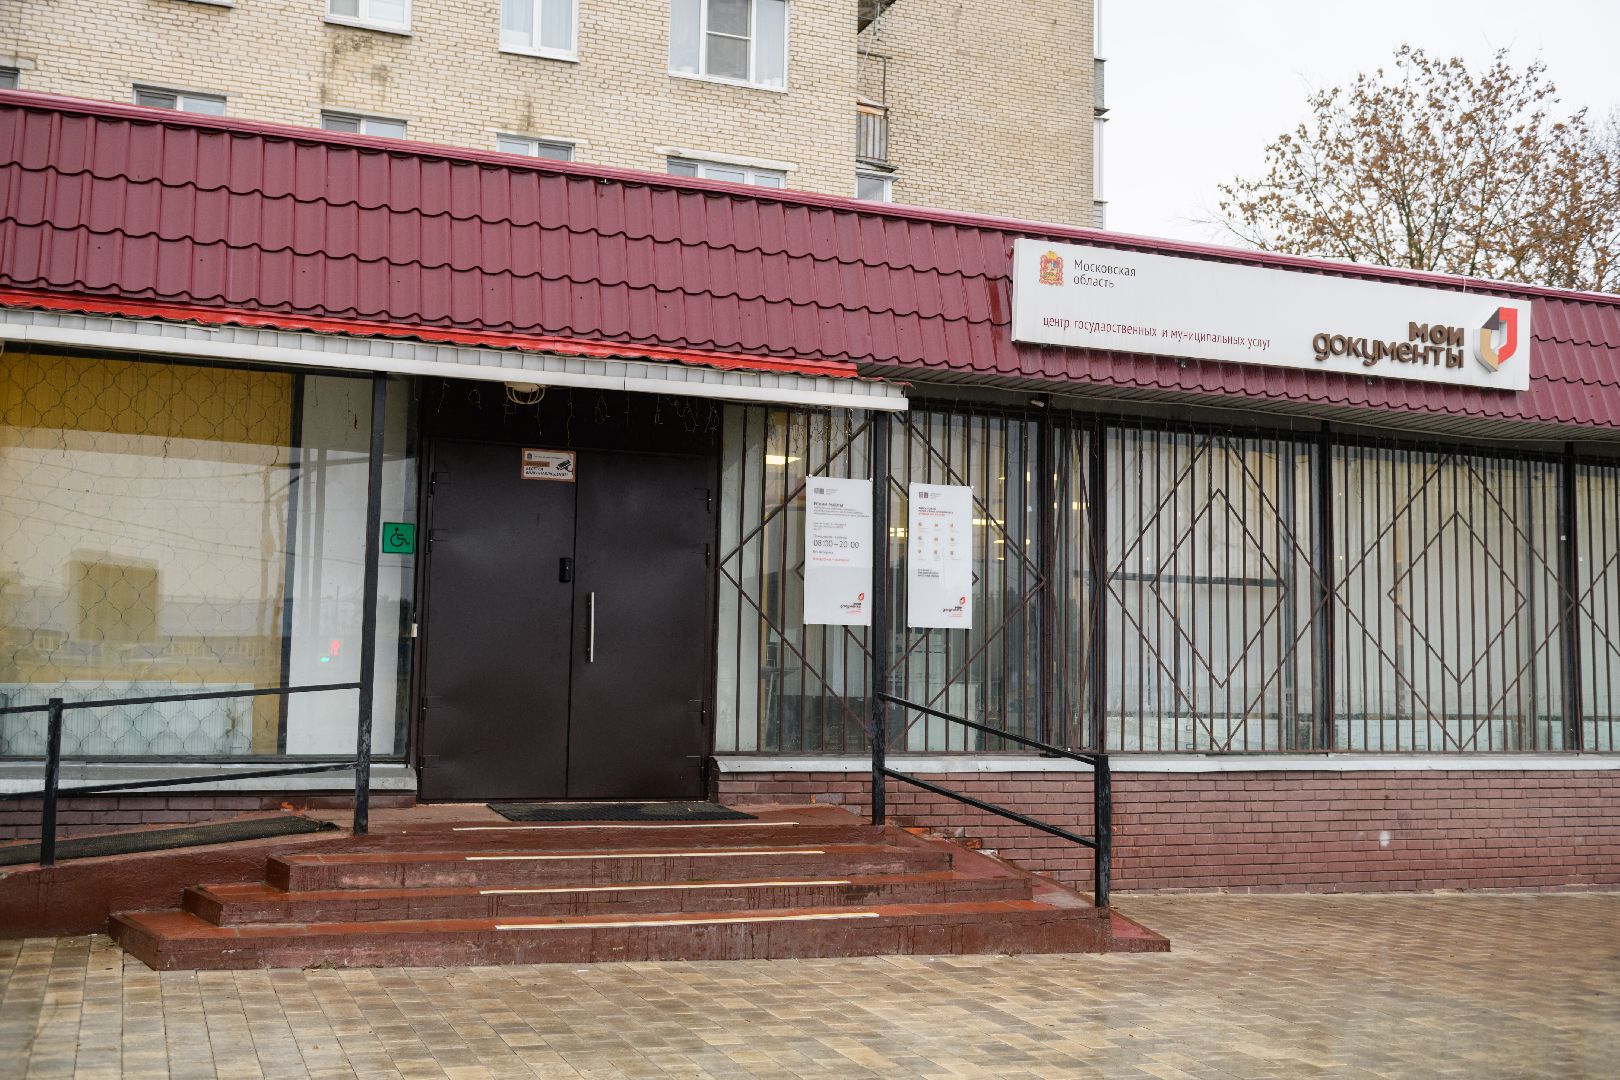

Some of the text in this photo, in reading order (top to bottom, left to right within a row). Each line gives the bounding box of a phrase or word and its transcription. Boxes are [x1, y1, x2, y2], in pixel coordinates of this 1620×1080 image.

[1074, 259, 1137, 277] Московская
[1073, 274, 1115, 289] область
[1043, 316, 1272, 351] центр государственных и муниципальных услуг
[1408, 321, 1465, 347] мои
[1312, 332, 1465, 369] документы
